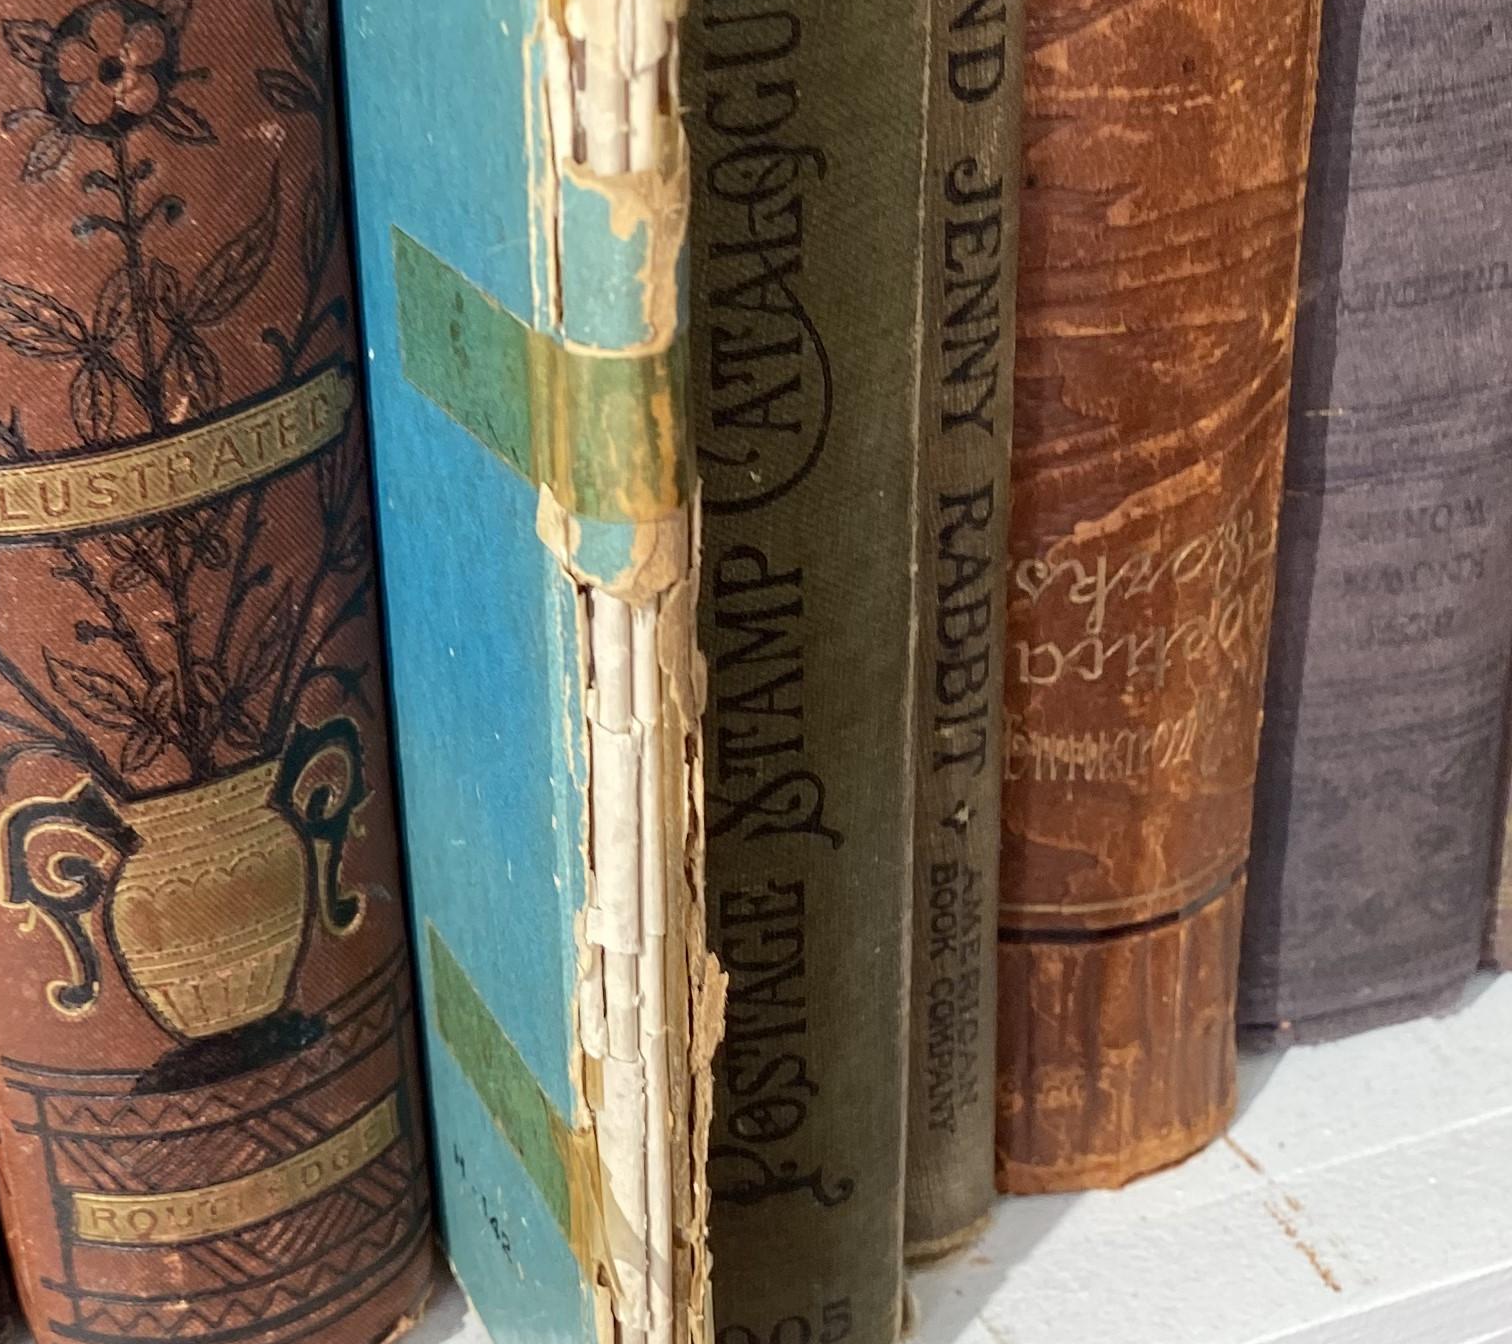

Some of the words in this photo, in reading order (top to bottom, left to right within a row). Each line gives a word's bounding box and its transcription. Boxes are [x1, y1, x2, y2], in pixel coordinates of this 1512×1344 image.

[940, 156, 1004, 437] JENNY
[704, 543, 845, 851] STAMP
[932, 477, 995, 779] RABBIT
[710, 878, 855, 1208] POSTAGE
[926, 976, 956, 1136] COMPANY
[927, 861, 958, 961] BOOK
